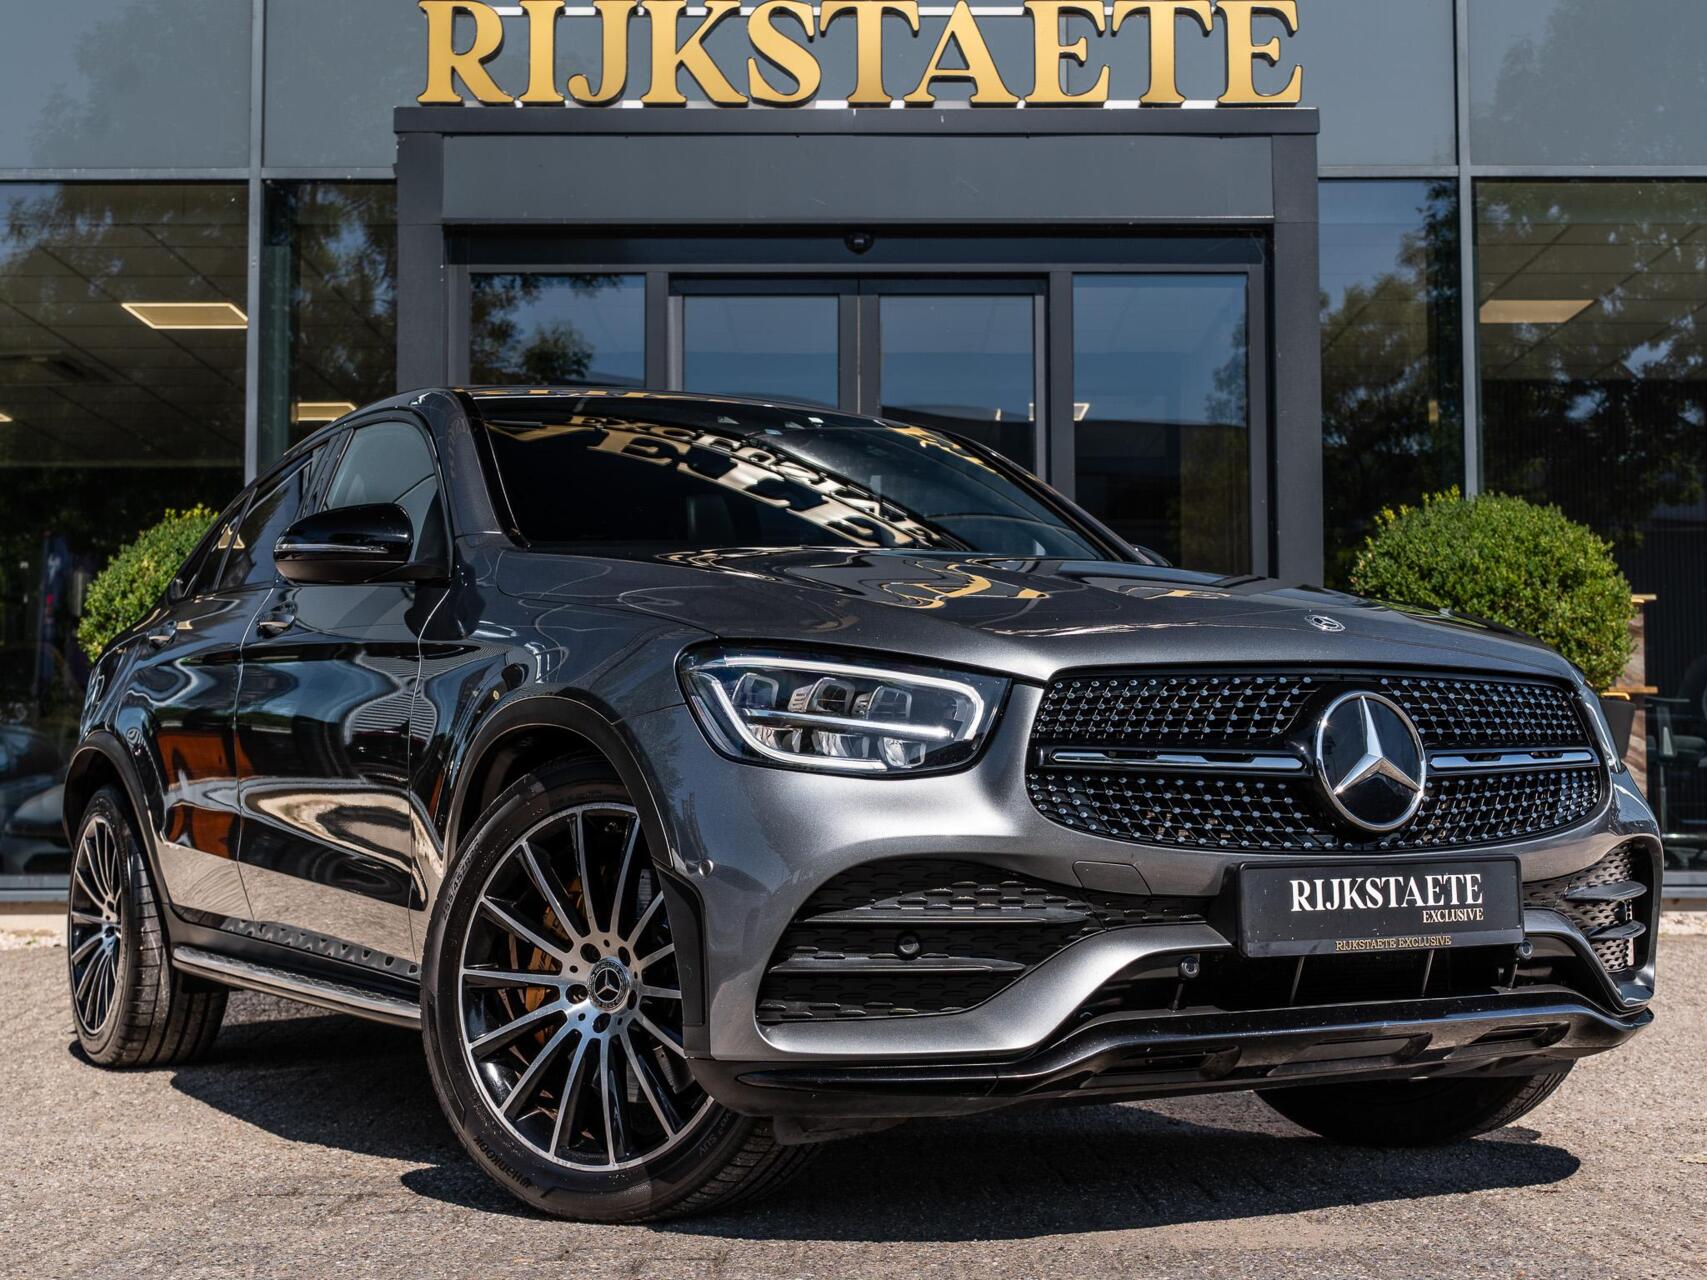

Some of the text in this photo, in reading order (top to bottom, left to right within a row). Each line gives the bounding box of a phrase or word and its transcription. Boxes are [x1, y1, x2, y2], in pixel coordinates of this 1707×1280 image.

[416, 0, 1304, 106] RIJKSTAETE
[1289, 873, 1483, 912] RIJKSTAETE
[1422, 907, 1484, 924] EXCLUSIVE
[1335, 935, 1453, 951] RIJKSTAETE EXCLUSIVE
